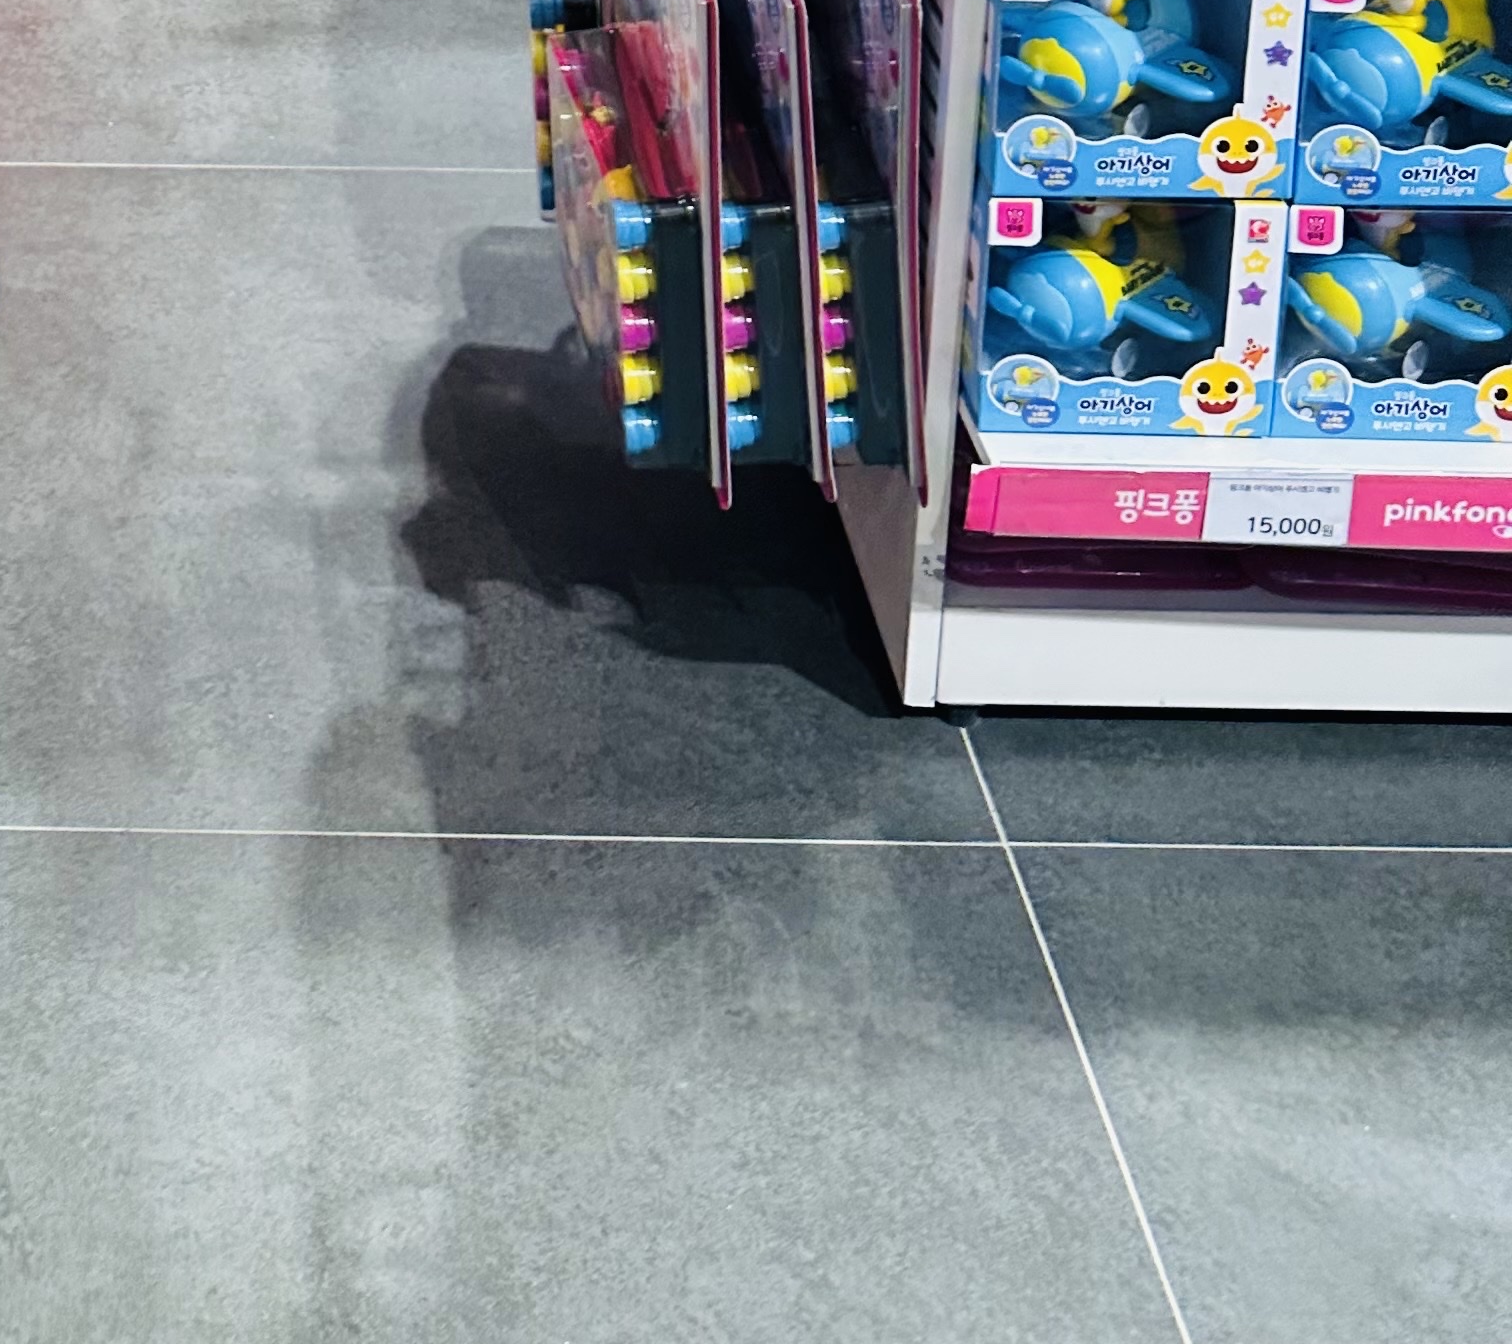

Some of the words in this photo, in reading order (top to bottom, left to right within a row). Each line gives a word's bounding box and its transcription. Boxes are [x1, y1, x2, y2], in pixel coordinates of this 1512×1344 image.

[1096, 154, 1171, 175] 아기상어
[1400, 165, 1477, 185] 아기상어
[1078, 396, 1152, 415] 아기상어
[1373, 402, 1448, 420] 아기상어
[1114, 489, 1200, 524] 핑크퐁
